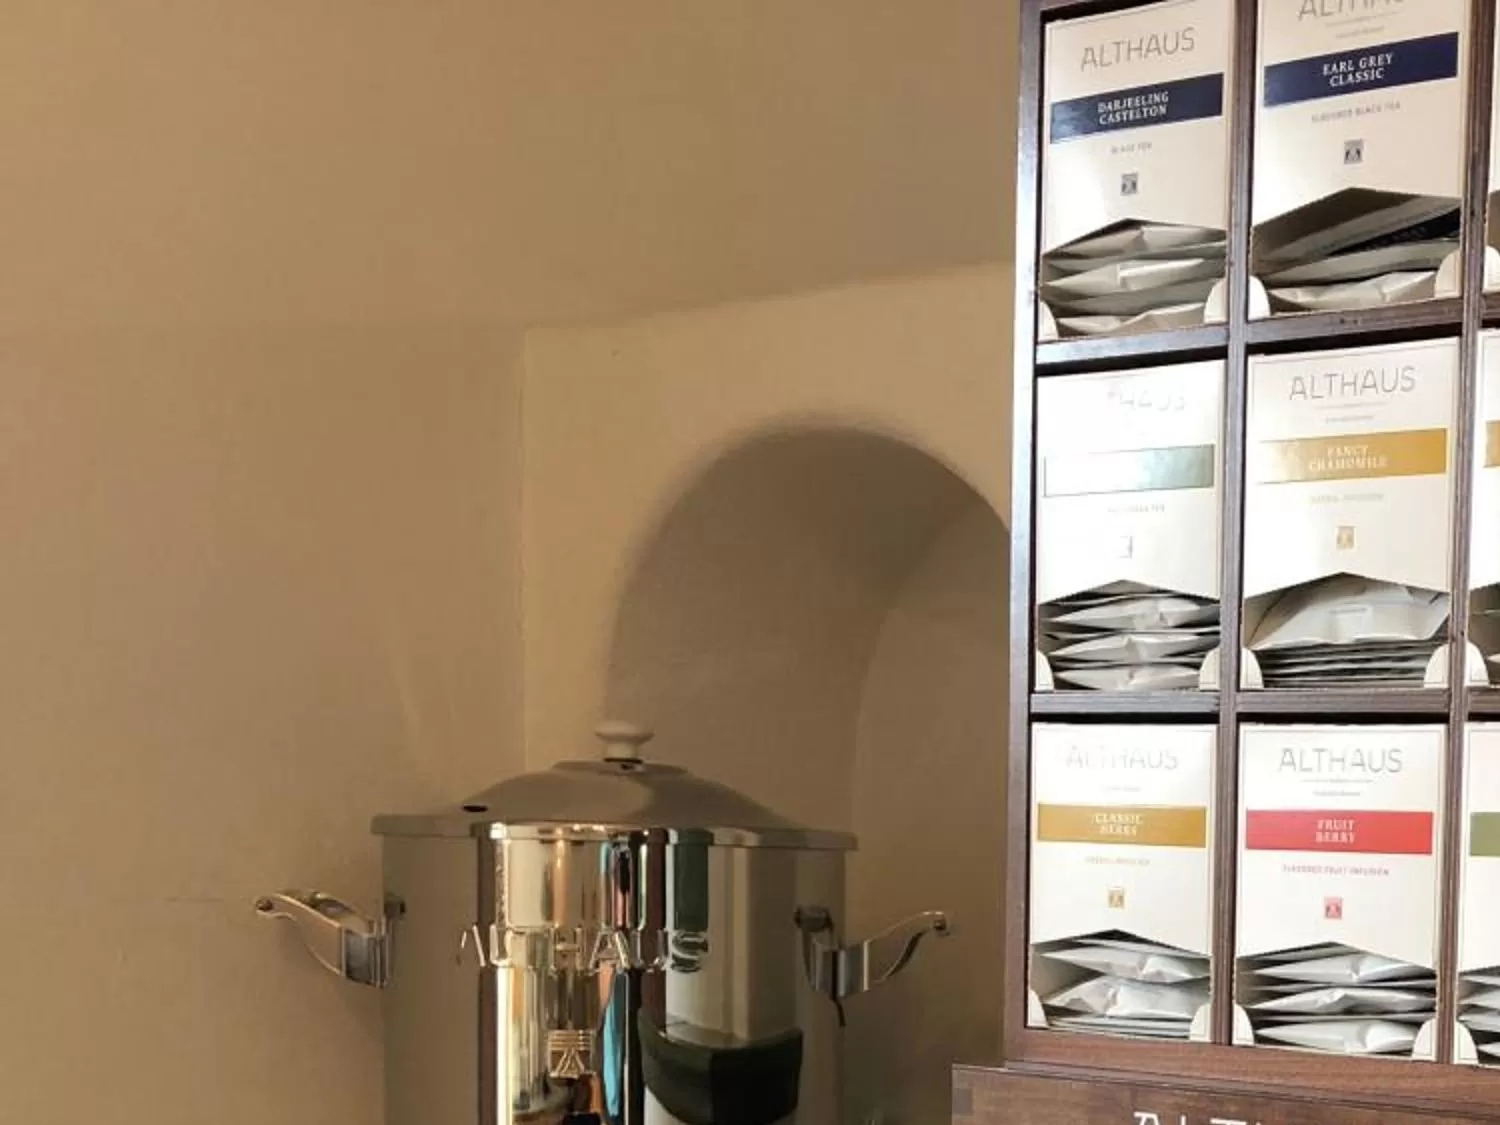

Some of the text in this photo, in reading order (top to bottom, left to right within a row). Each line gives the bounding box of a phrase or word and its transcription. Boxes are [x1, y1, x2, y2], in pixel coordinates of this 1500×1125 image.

[1081, 27, 1196, 71] ALTHAUS
[1323, 52, 1394, 76] EARL GREY
[1329, 67, 1385, 87] CLASSIC
[1098, 91, 1170, 113] DARJEELING
[1099, 104, 1168, 125] CASTELTON
[1289, 365, 1416, 401] ALTHAUS
[1279, 747, 1403, 773] ALTHAUS
